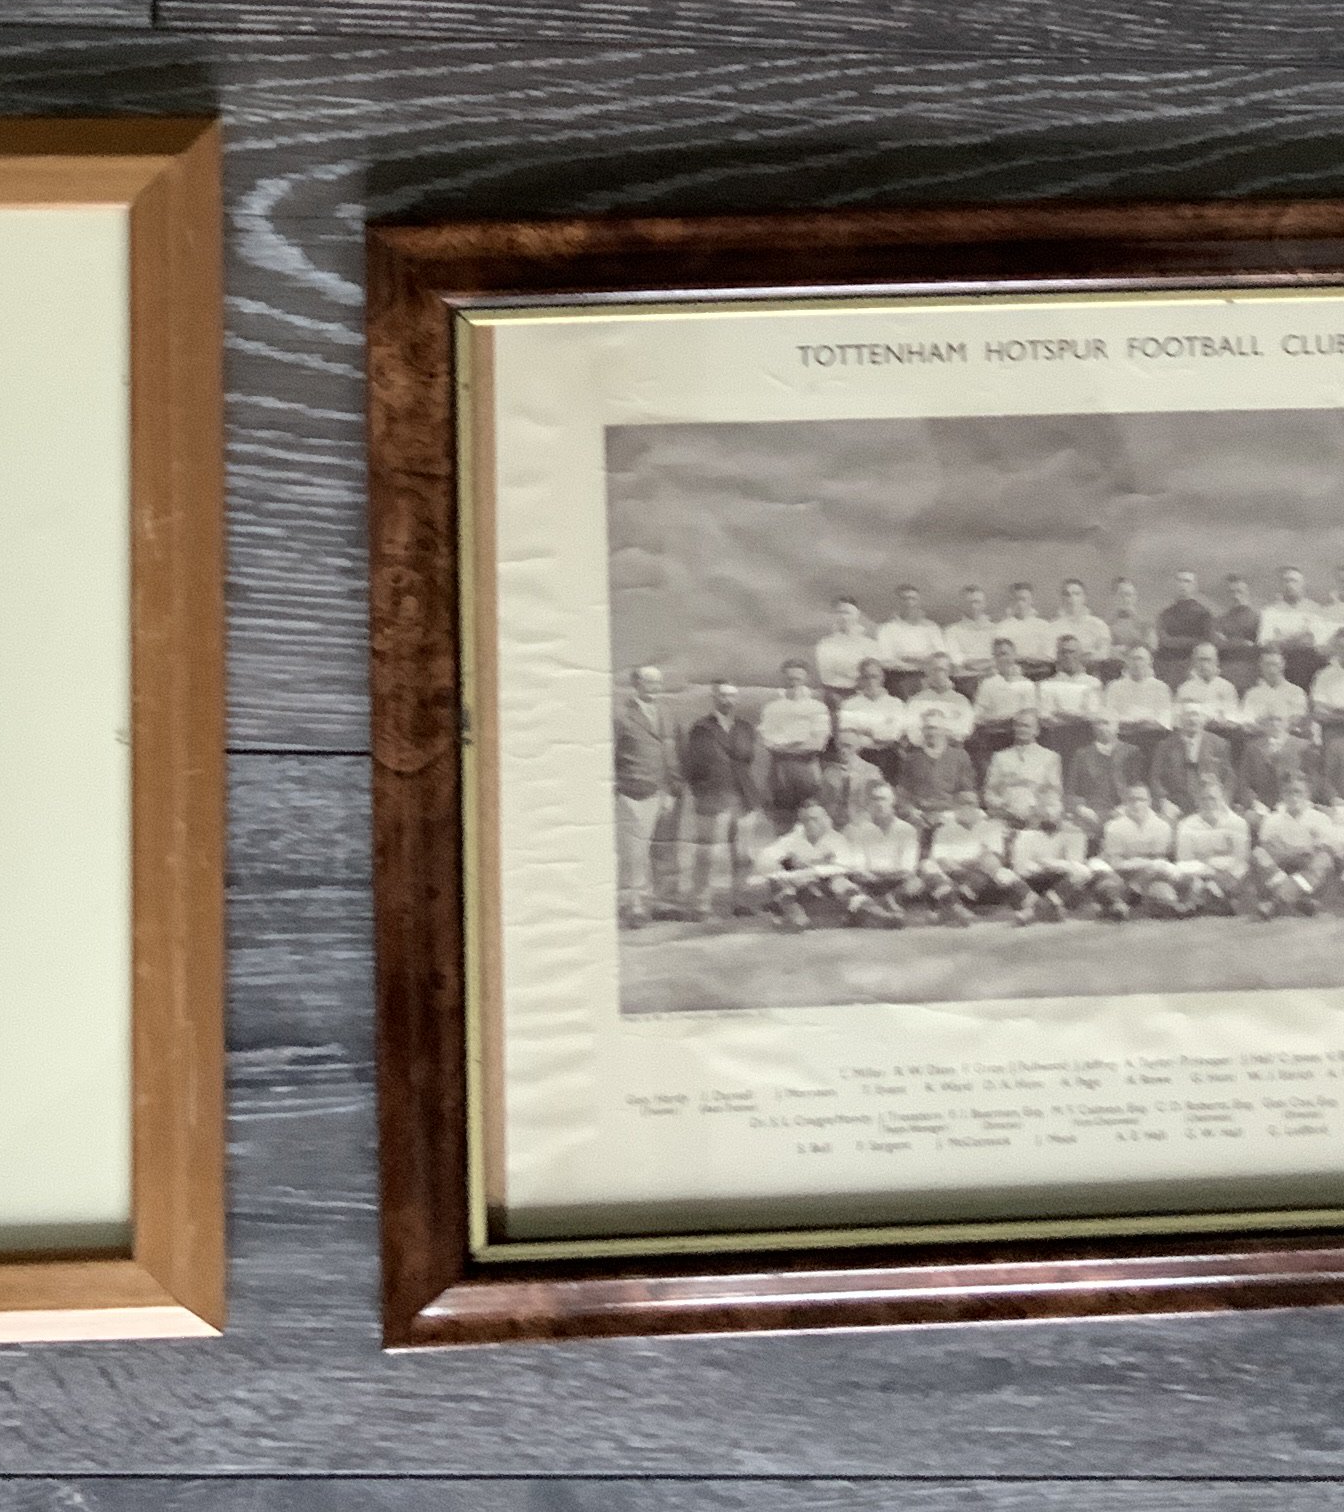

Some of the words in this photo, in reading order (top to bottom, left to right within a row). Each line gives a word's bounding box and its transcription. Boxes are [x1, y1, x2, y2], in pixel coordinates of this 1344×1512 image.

[795, 340, 969, 368] TOTTENHAM
[983, 337, 1110, 363] HOTSPUR
[1126, 334, 1266, 359] FOOTBALL
